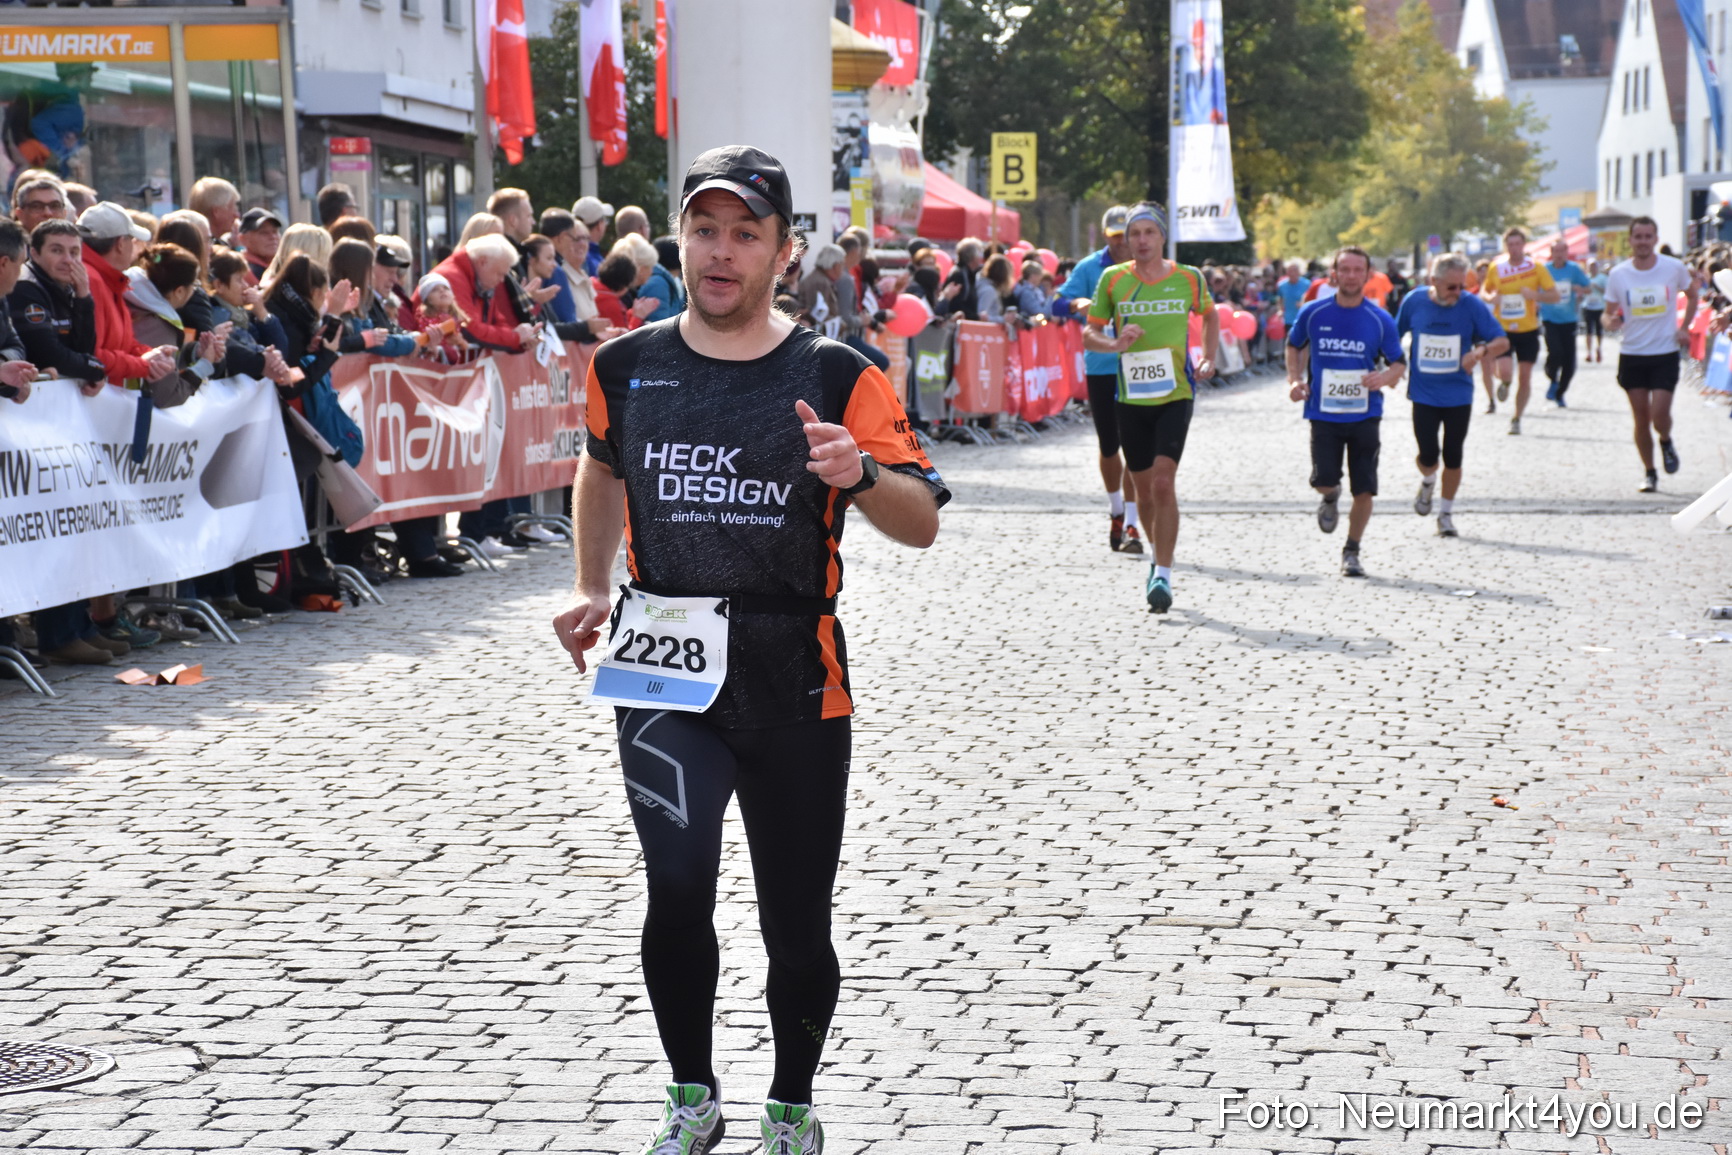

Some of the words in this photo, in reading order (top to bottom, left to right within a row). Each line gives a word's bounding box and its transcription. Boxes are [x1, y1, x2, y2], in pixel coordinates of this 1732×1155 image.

[0, 34, 154, 56] UNMARKT.DE
[997, 136, 1030, 148] Block
[1004, 154, 1024, 184] B
[1286, 227, 1299, 247] C
[1118, 300, 1185, 316] BOCK
[1318, 338, 1366, 352] SYSCAD
[1424, 346, 1452, 358] 2751
[1130, 364, 1166, 380] 2785
[1328, 384, 1361, 397] 2465
[644, 443, 742, 474] HECK
[658, 474, 792, 506] DESIGN
[45, 500, 120, 538] VERBRAUCH.
[720, 512, 786, 527] Werbung!
[614, 628, 707, 673] 2228
[646, 681, 665, 695] Uli
[635, 792, 659, 808] 2XU
